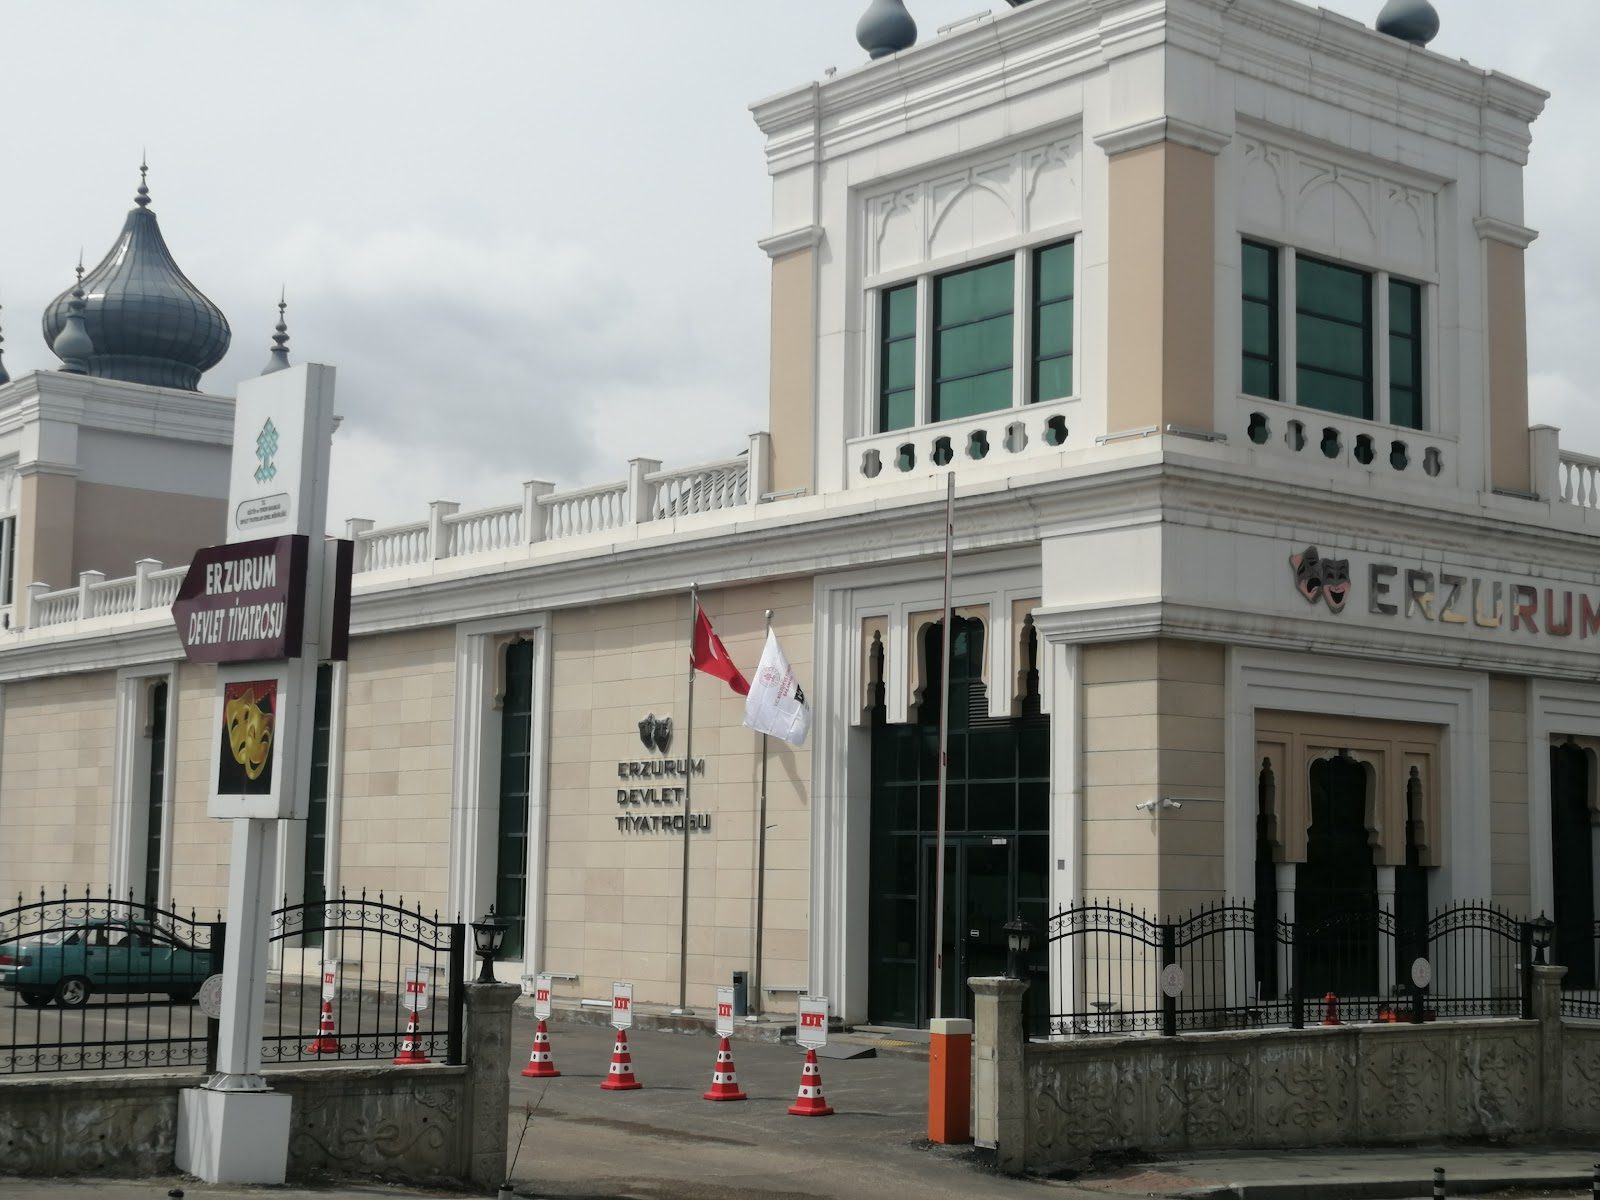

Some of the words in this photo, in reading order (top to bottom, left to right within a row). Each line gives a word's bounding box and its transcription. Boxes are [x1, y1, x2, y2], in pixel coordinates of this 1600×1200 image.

[206, 554, 276, 595] ERZURUM
[1368, 563, 1600, 640] ERZURUM
[188, 609, 225, 645] DEVLET
[227, 597, 284, 642] TİYATROSU
[618, 759, 705, 777] ERZURUM
[617, 788, 684, 804] DEVLET
[615, 811, 711, 832] TİYATROSU
